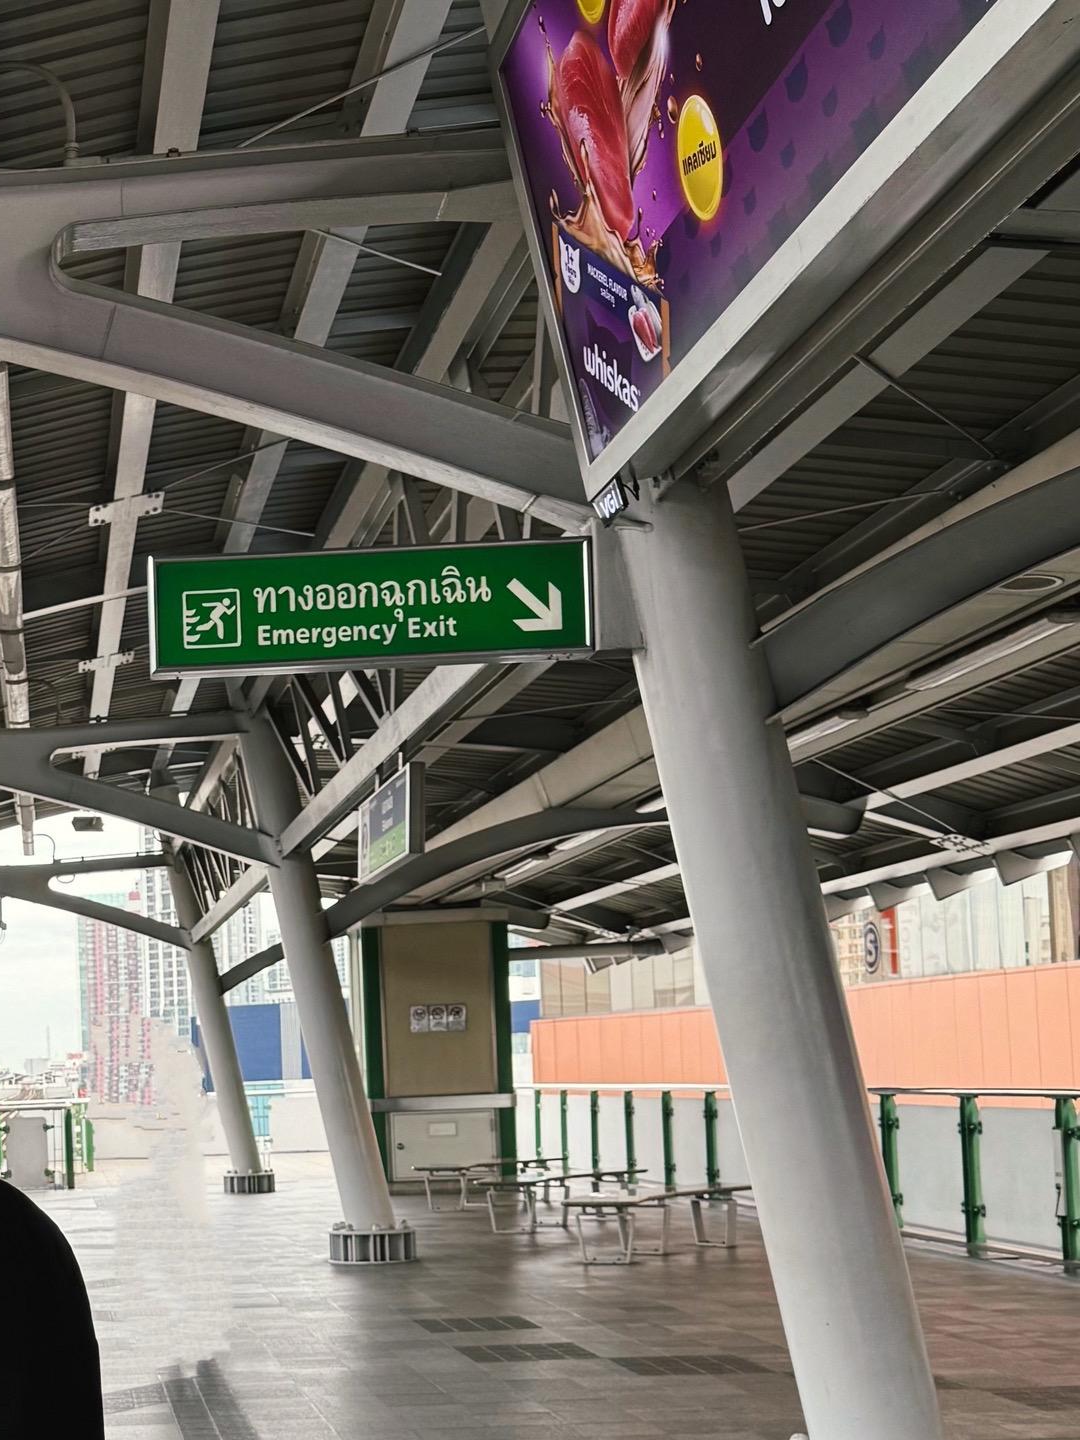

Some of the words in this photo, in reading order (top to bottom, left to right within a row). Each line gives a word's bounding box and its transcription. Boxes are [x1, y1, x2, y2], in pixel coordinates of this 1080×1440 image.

[682, 141, 717, 176] แคลเซียม
[583, 343, 639, 413] whiskas
[252, 565, 492, 623] ทางออกฉุกเฉิน
[257, 622, 398, 648] Emergency
[406, 614, 458, 639] Exit
